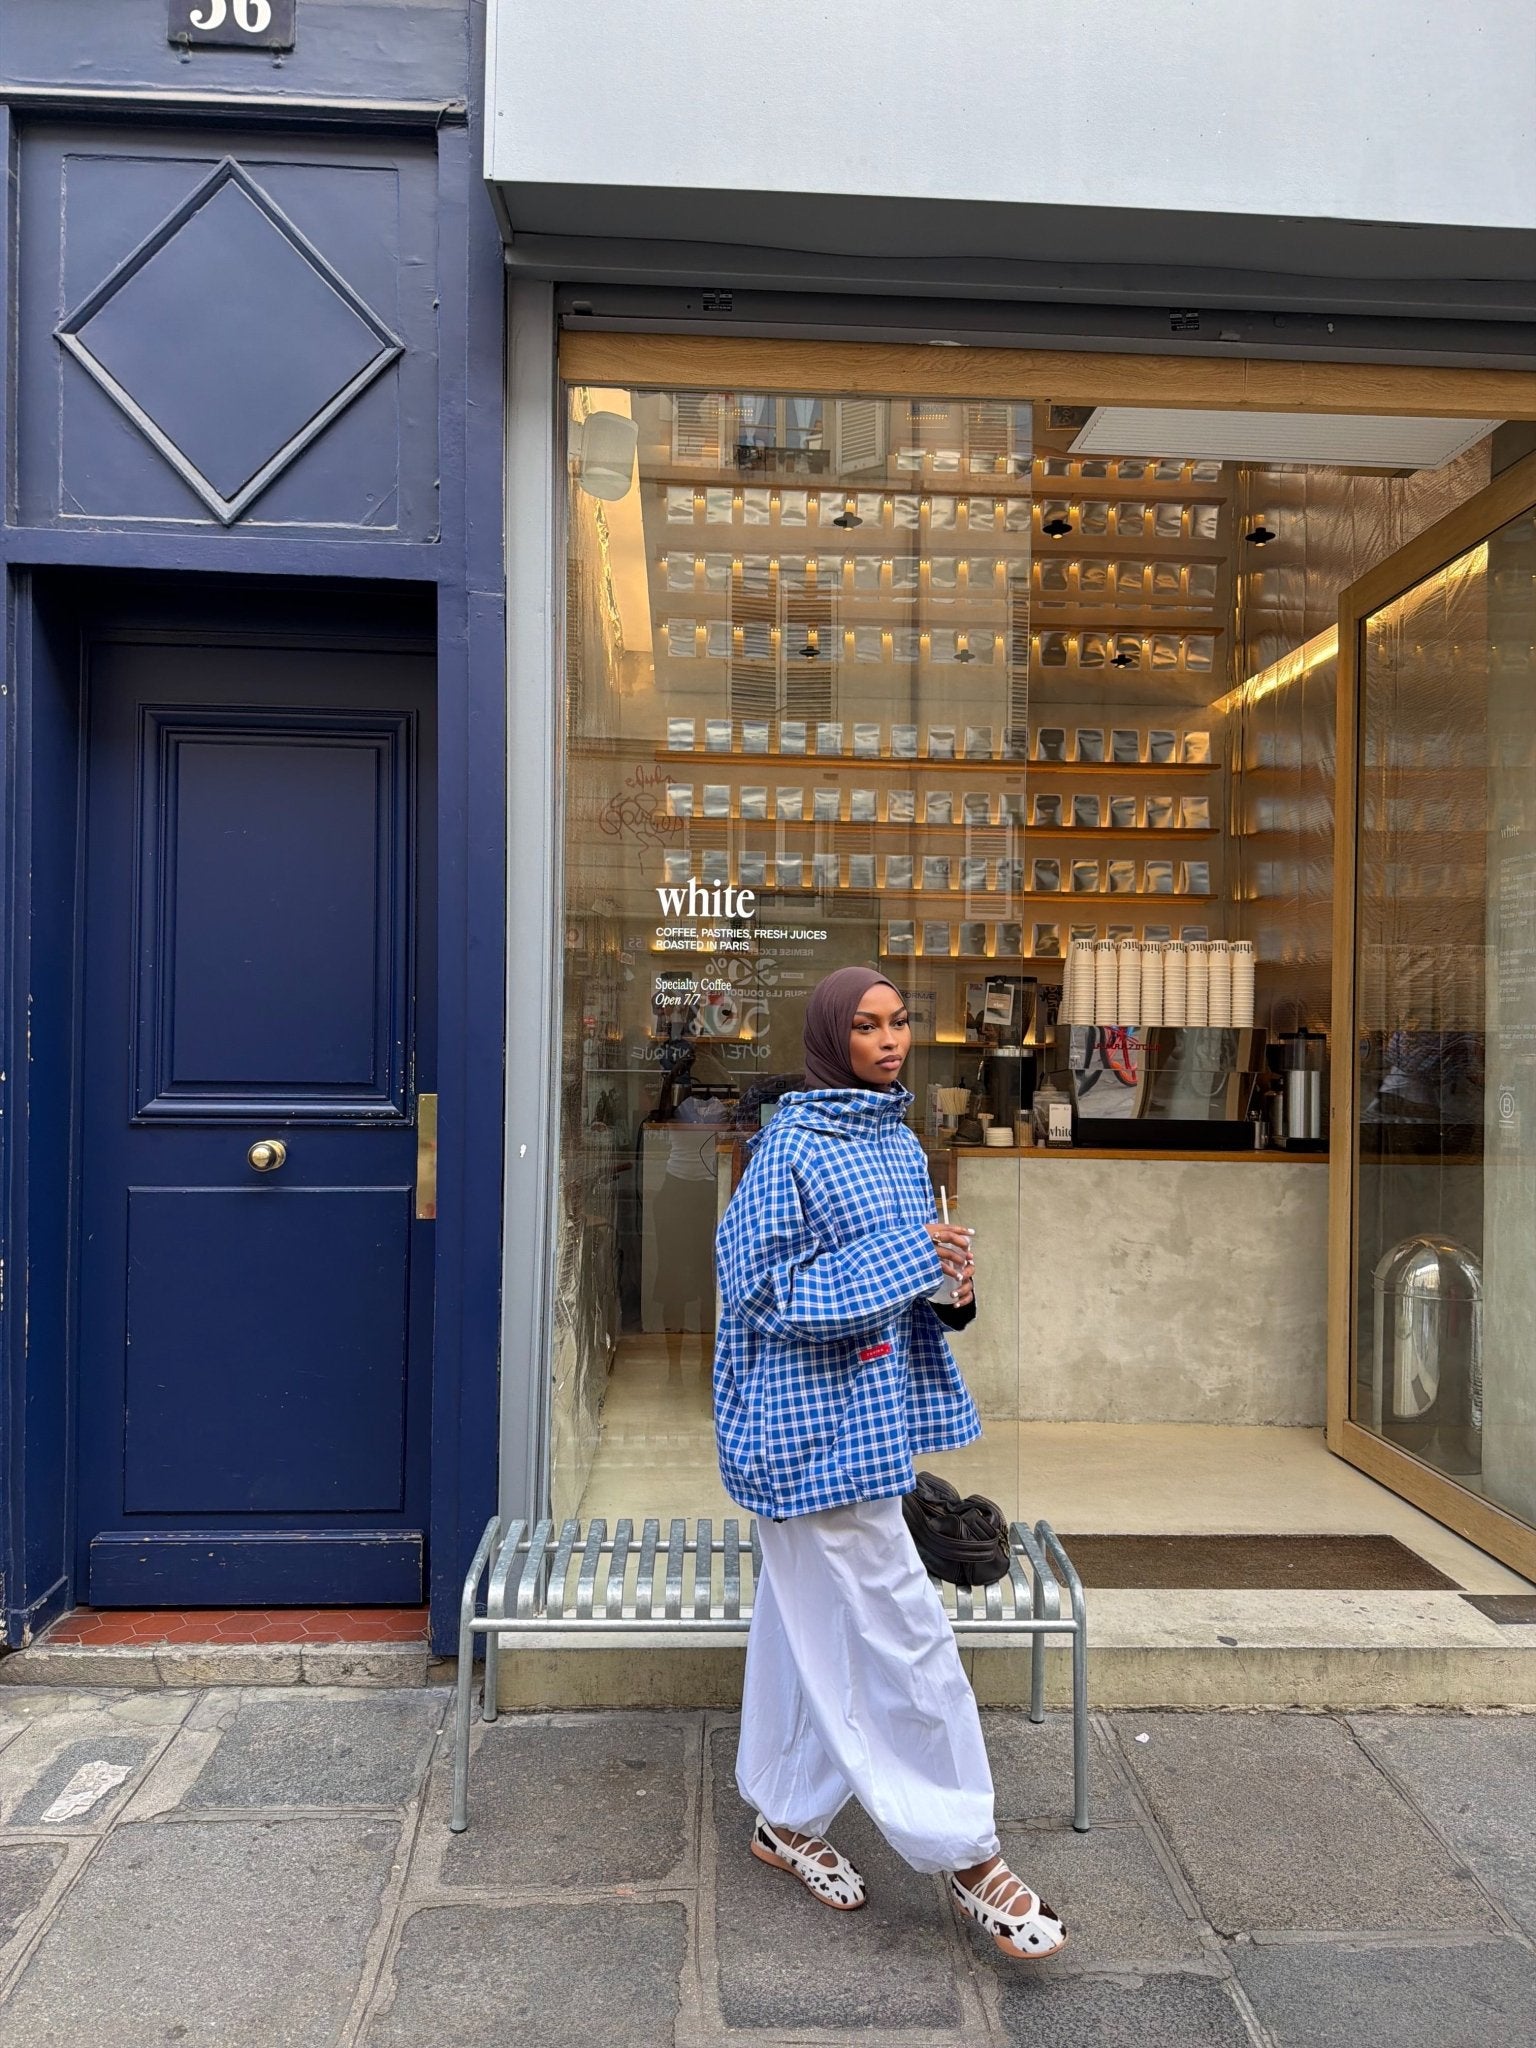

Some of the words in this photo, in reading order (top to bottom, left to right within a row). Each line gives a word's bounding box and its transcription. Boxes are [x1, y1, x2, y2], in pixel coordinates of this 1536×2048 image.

[656, 876, 755, 918] white
[656, 927, 699, 938] COFFEE,
[701, 928, 752, 939] PASTRIES,
[754, 929, 788, 939] FRESH
[789, 930, 827, 940] JUICES
[656, 940, 704, 950] ROASTED
[706, 940, 717, 950] IN
[720, 941, 749, 951] PARIS
[655, 977, 699, 993] Specialty
[700, 978, 732, 991] Coffee
[655, 992, 682, 1008] Open
[683, 993, 701, 1006] 7/7
